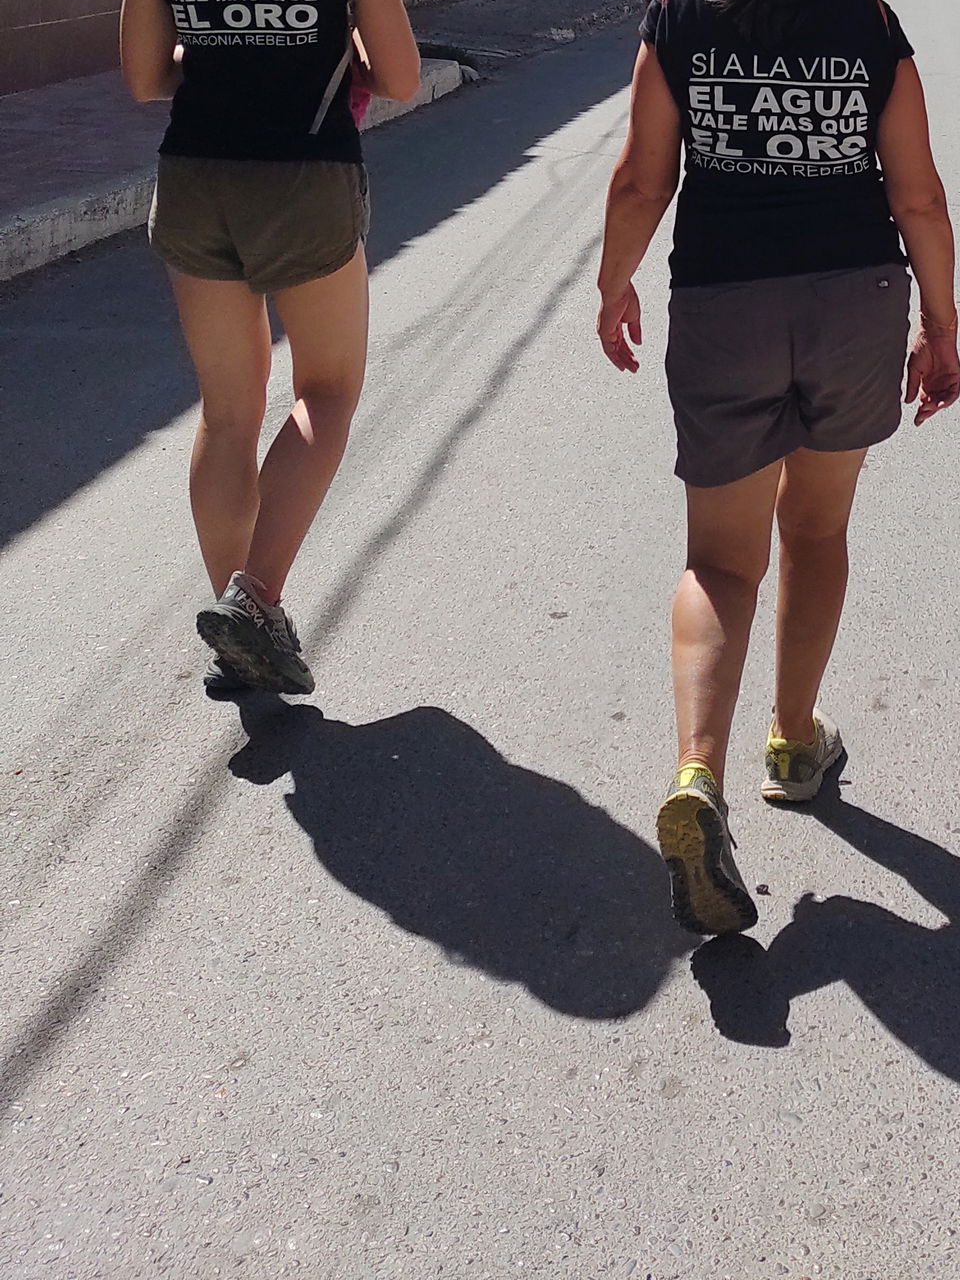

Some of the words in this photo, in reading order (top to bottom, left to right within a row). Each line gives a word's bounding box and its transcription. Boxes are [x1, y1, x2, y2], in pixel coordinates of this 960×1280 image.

[171, 4, 211, 29] EL
[223, 4, 318, 29] ORO
[245, 33, 318, 46] REBELDE
[692, 48, 716, 76] SÍ
[723, 53, 744, 76] A
[753, 55, 791, 79] LA
[798, 57, 869, 81] VIDA
[688, 86, 736, 112] EL
[751, 87, 868, 117] AGUA
[688, 110, 748, 130] VALE
[758, 116, 814, 132] MAS
[821, 116, 868, 135] QUE
[689, 127, 743, 156] EL
[691, 151, 787, 176] PATAGONIA
[237, 592, 265, 628] HOKA
